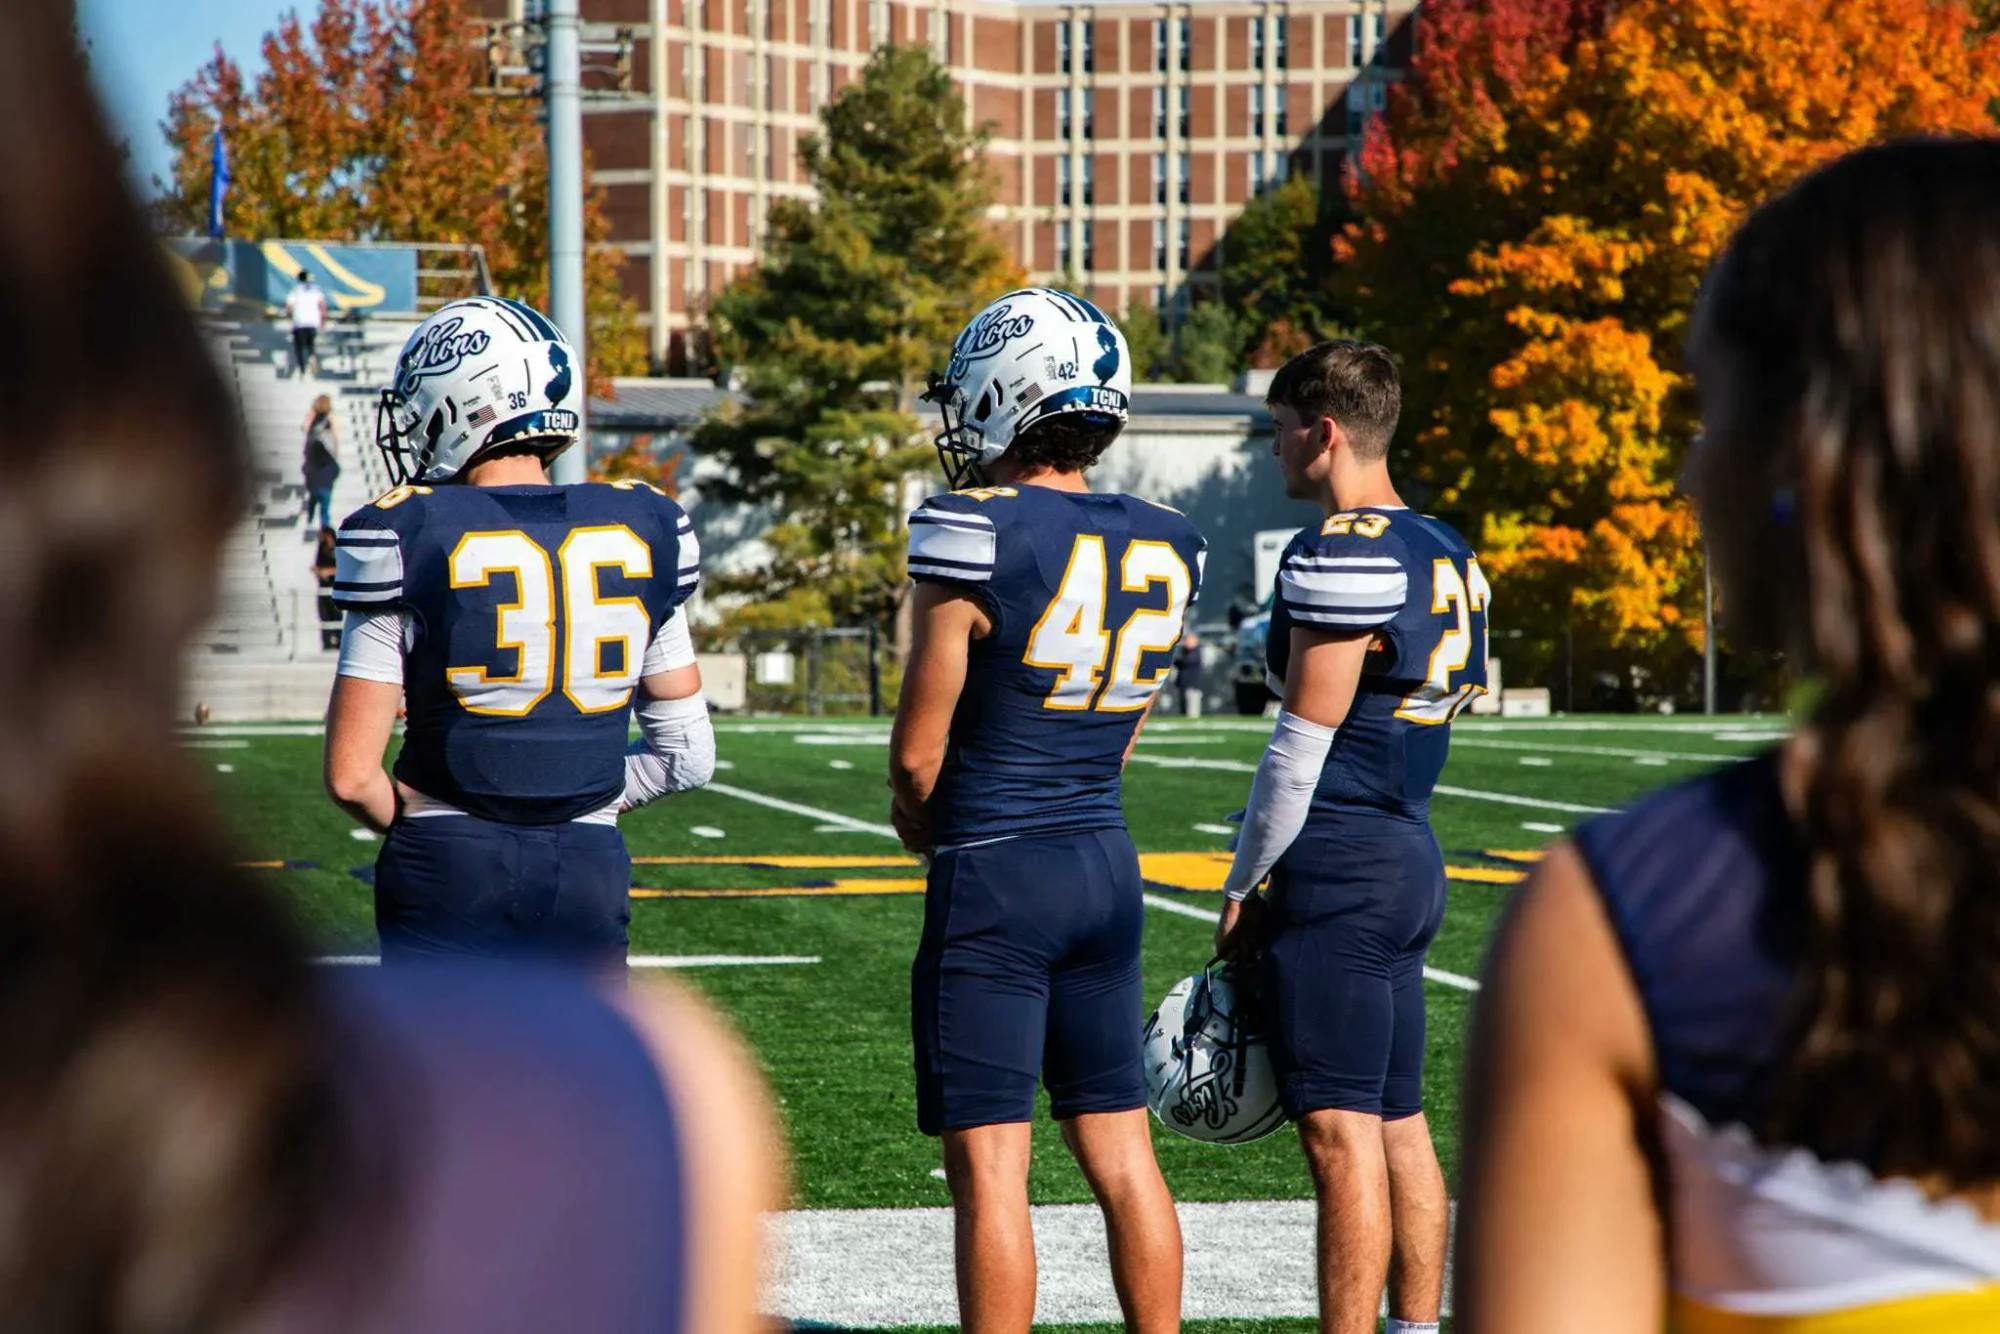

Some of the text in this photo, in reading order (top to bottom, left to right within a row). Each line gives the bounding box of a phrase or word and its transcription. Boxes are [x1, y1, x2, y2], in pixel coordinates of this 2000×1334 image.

[398, 316, 490, 395] Lions
[1058, 361, 1076, 380] 42
[508, 391, 527, 410] 36
[1090, 387, 1121, 407] TCNJ
[542, 411, 574, 430] TCNJ
[1320, 512, 1391, 539] 23
[446, 524, 653, 717] 36
[1022, 533, 1192, 712] 42
